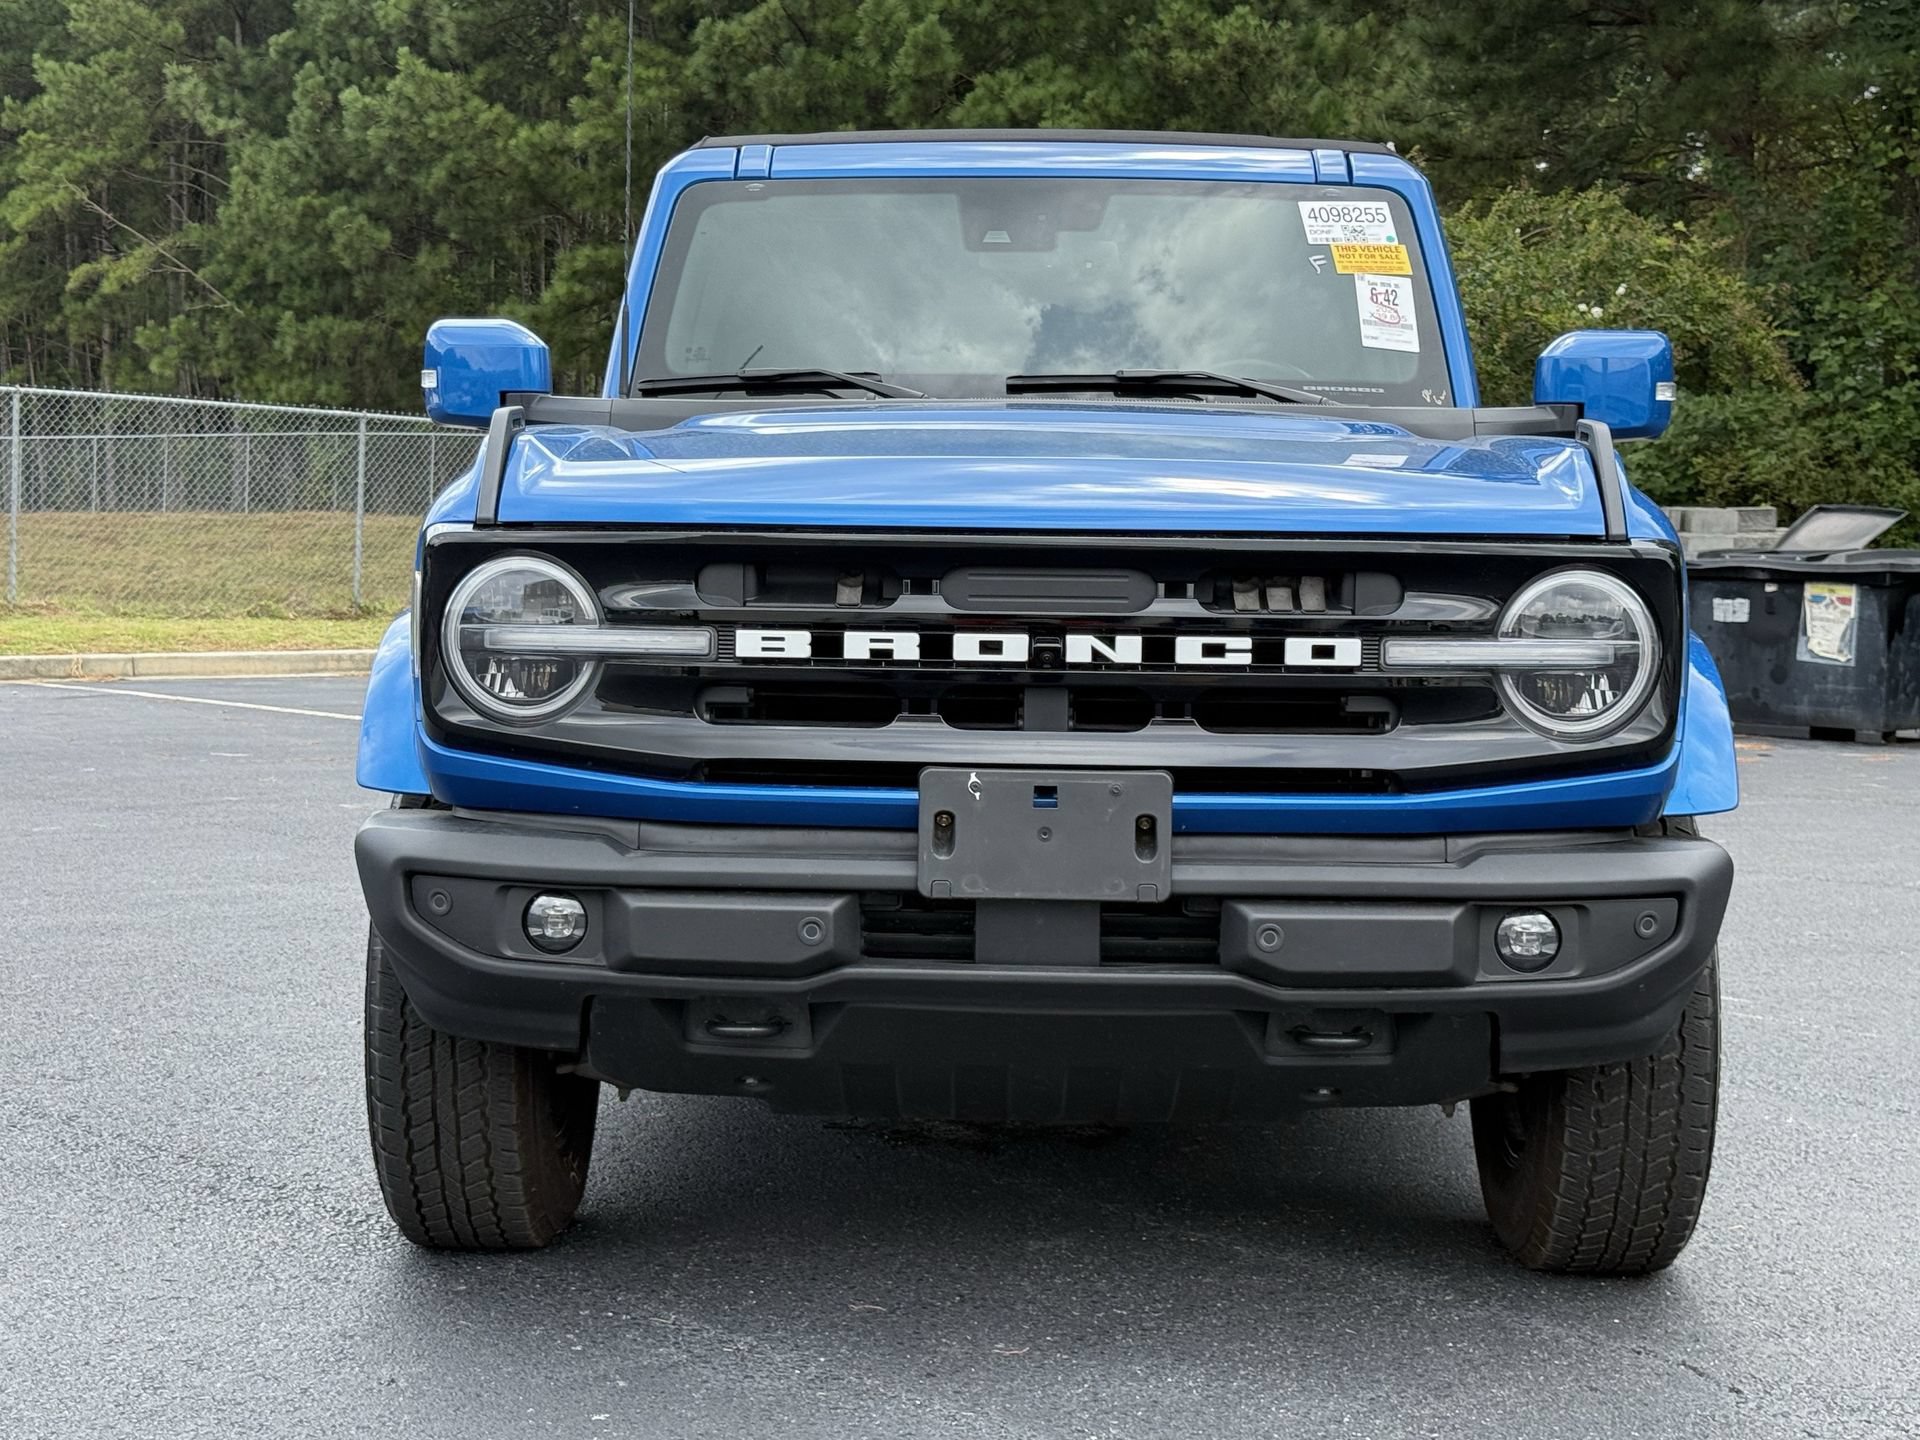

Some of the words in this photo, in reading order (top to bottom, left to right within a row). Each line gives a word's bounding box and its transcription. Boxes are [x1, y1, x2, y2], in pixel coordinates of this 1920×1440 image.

[1308, 206, 1387, 224] 4098255
[1334, 245, 1358, 253] THIS
[1359, 246, 1402, 254] VEHICLE
[735, 629, 1363, 667] BRONCO
